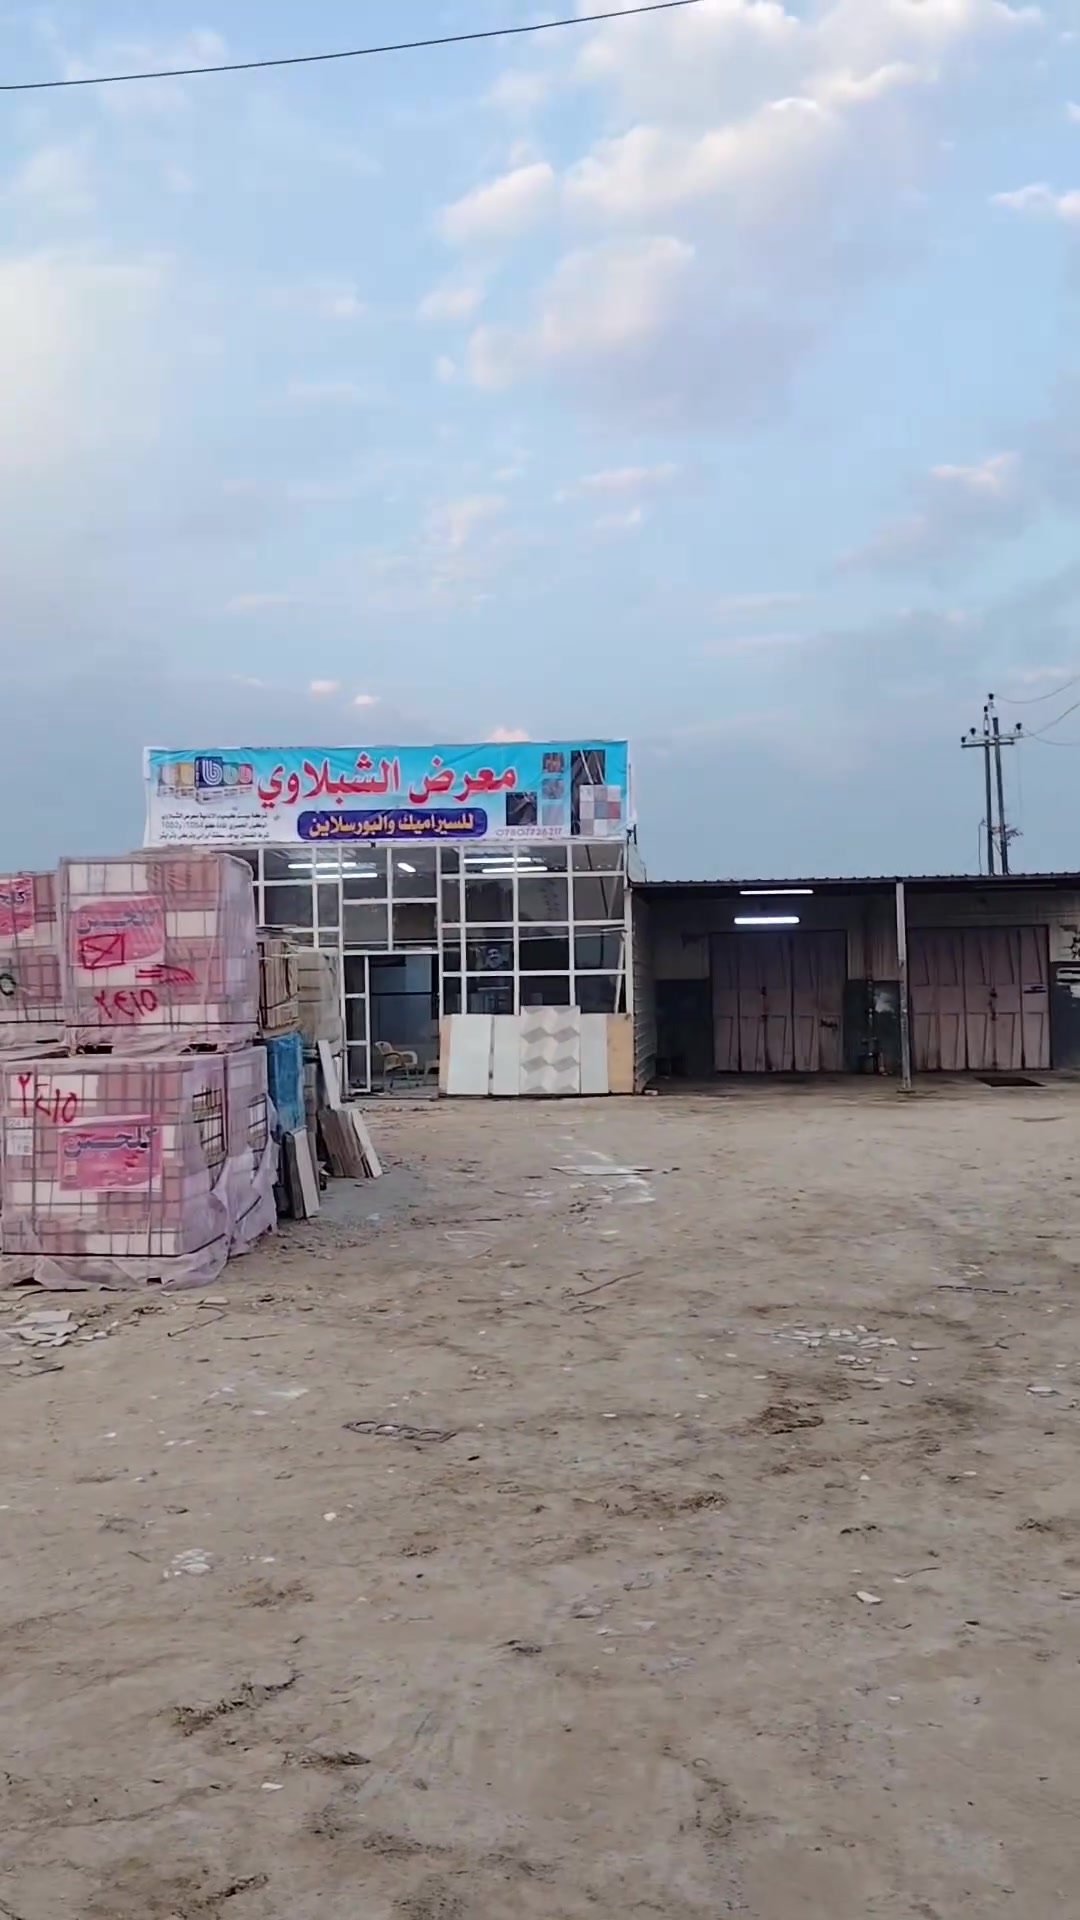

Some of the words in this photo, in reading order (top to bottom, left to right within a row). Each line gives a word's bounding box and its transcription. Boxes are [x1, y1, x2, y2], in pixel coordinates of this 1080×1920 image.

[257, 752, 399, 808] الشبلاوي
[410, 755, 517, 804] معرض
[308, 814, 396, 838] والبورسلاين
[398, 811, 474, 835] للسيراميك
